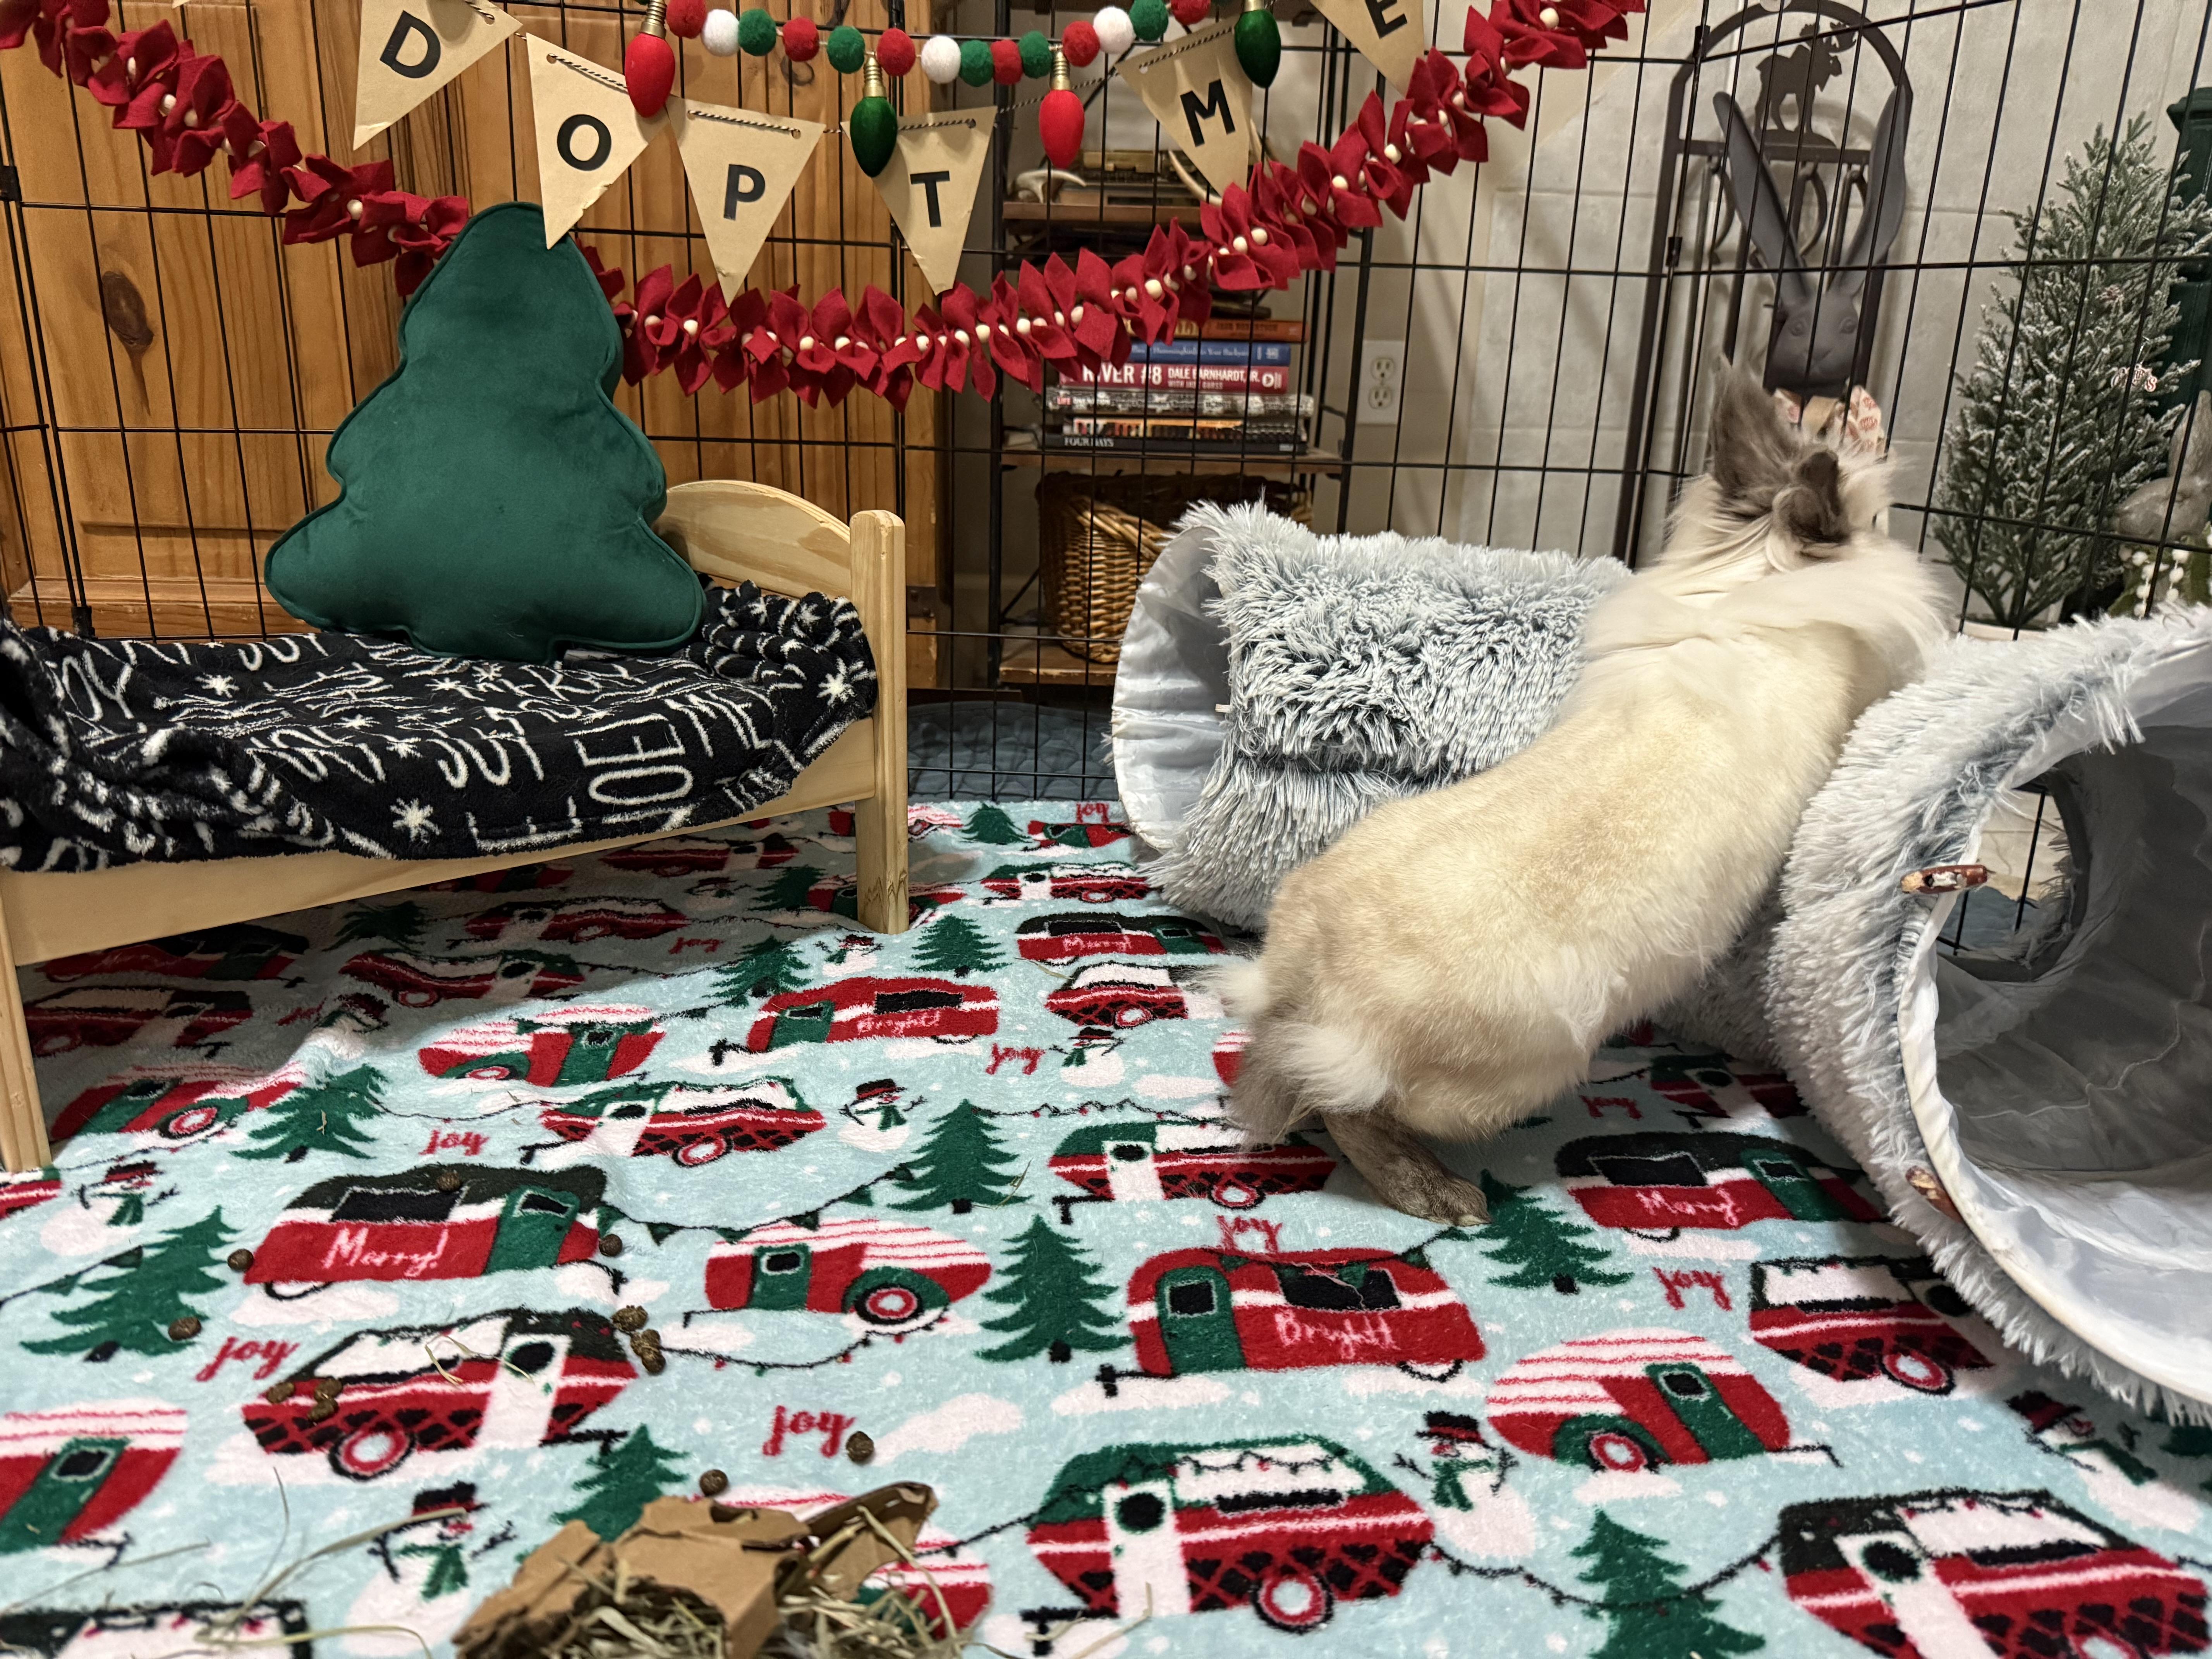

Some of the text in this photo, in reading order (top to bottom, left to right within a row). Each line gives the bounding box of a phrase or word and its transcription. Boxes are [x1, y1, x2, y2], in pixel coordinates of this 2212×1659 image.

[1168, 367, 1190, 380] DALE
[1075, 802, 1109, 824] joy
[985, 1043, 1047, 1075] joy
[419, 1129, 490, 1156] joy
[321, 1226, 449, 1277] Merry!
[1216, 1214, 1283, 1254] joy
[1652, 1267, 1733, 1310] joy
[195, 1336, 300, 1381] joy
[762, 1405, 856, 1458] joy
